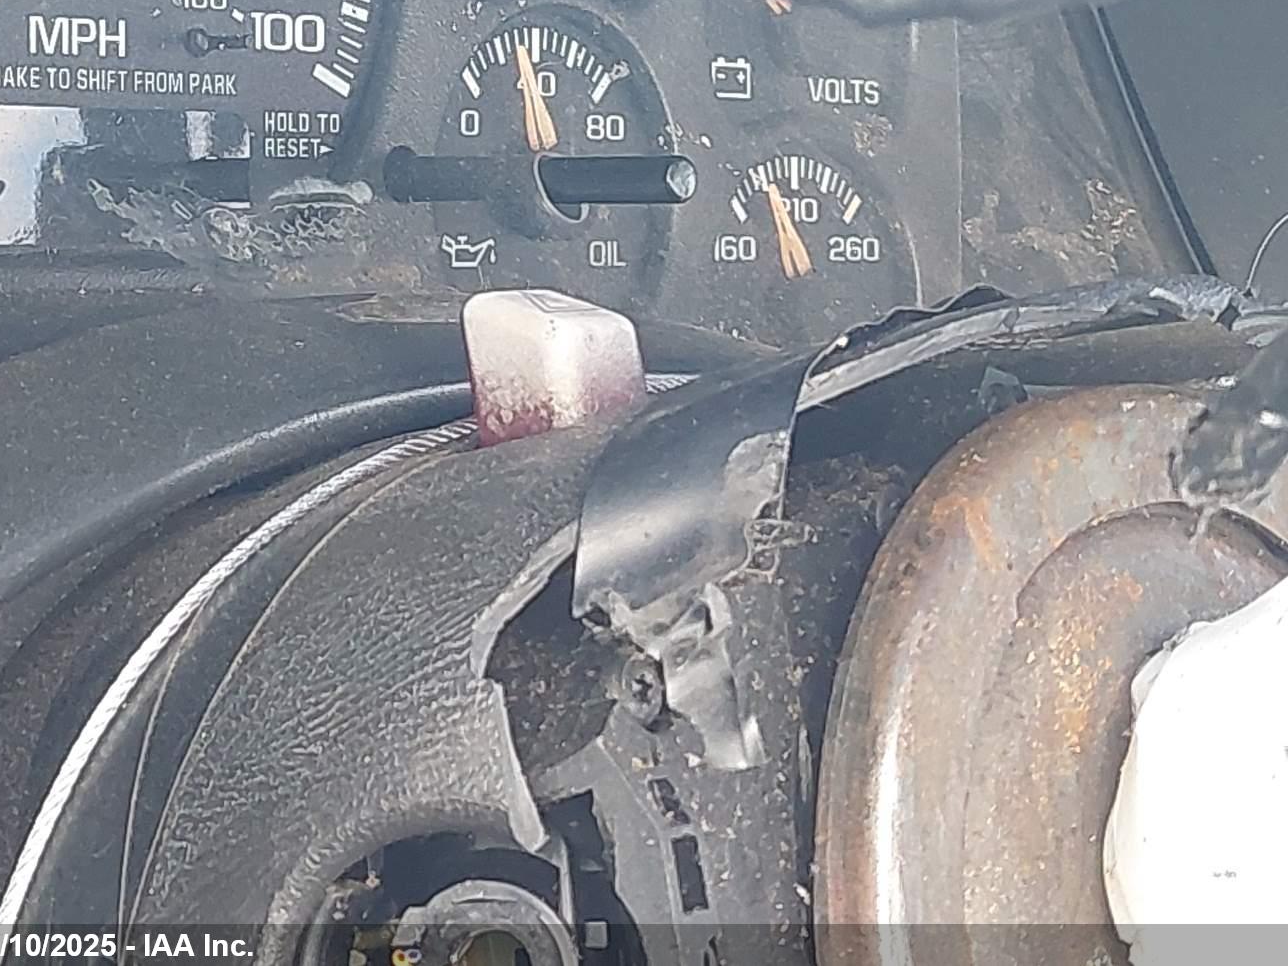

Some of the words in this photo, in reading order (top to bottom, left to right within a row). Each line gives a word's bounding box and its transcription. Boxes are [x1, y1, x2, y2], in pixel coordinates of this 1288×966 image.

[28, 15, 127, 58] MPH
[250, 12, 325, 53] 100
[47, 67, 71, 90] TO
[76, 68, 128, 92] SHIFT
[134, 71, 184, 95] FROM
[189, 73, 238, 96] PARK
[516, 71, 556, 96] 0
[807, 77, 880, 105] VOLTS
[264, 111, 310, 133] HOLD
[316, 113, 340, 134] TO
[460, 110, 479, 136] 0
[586, 114, 625, 141] 80
[264, 137, 322, 159] RESET
[588, 240, 627, 267] OIL
[714, 235, 757, 262] 160
[828, 237, 881, 263] 260
